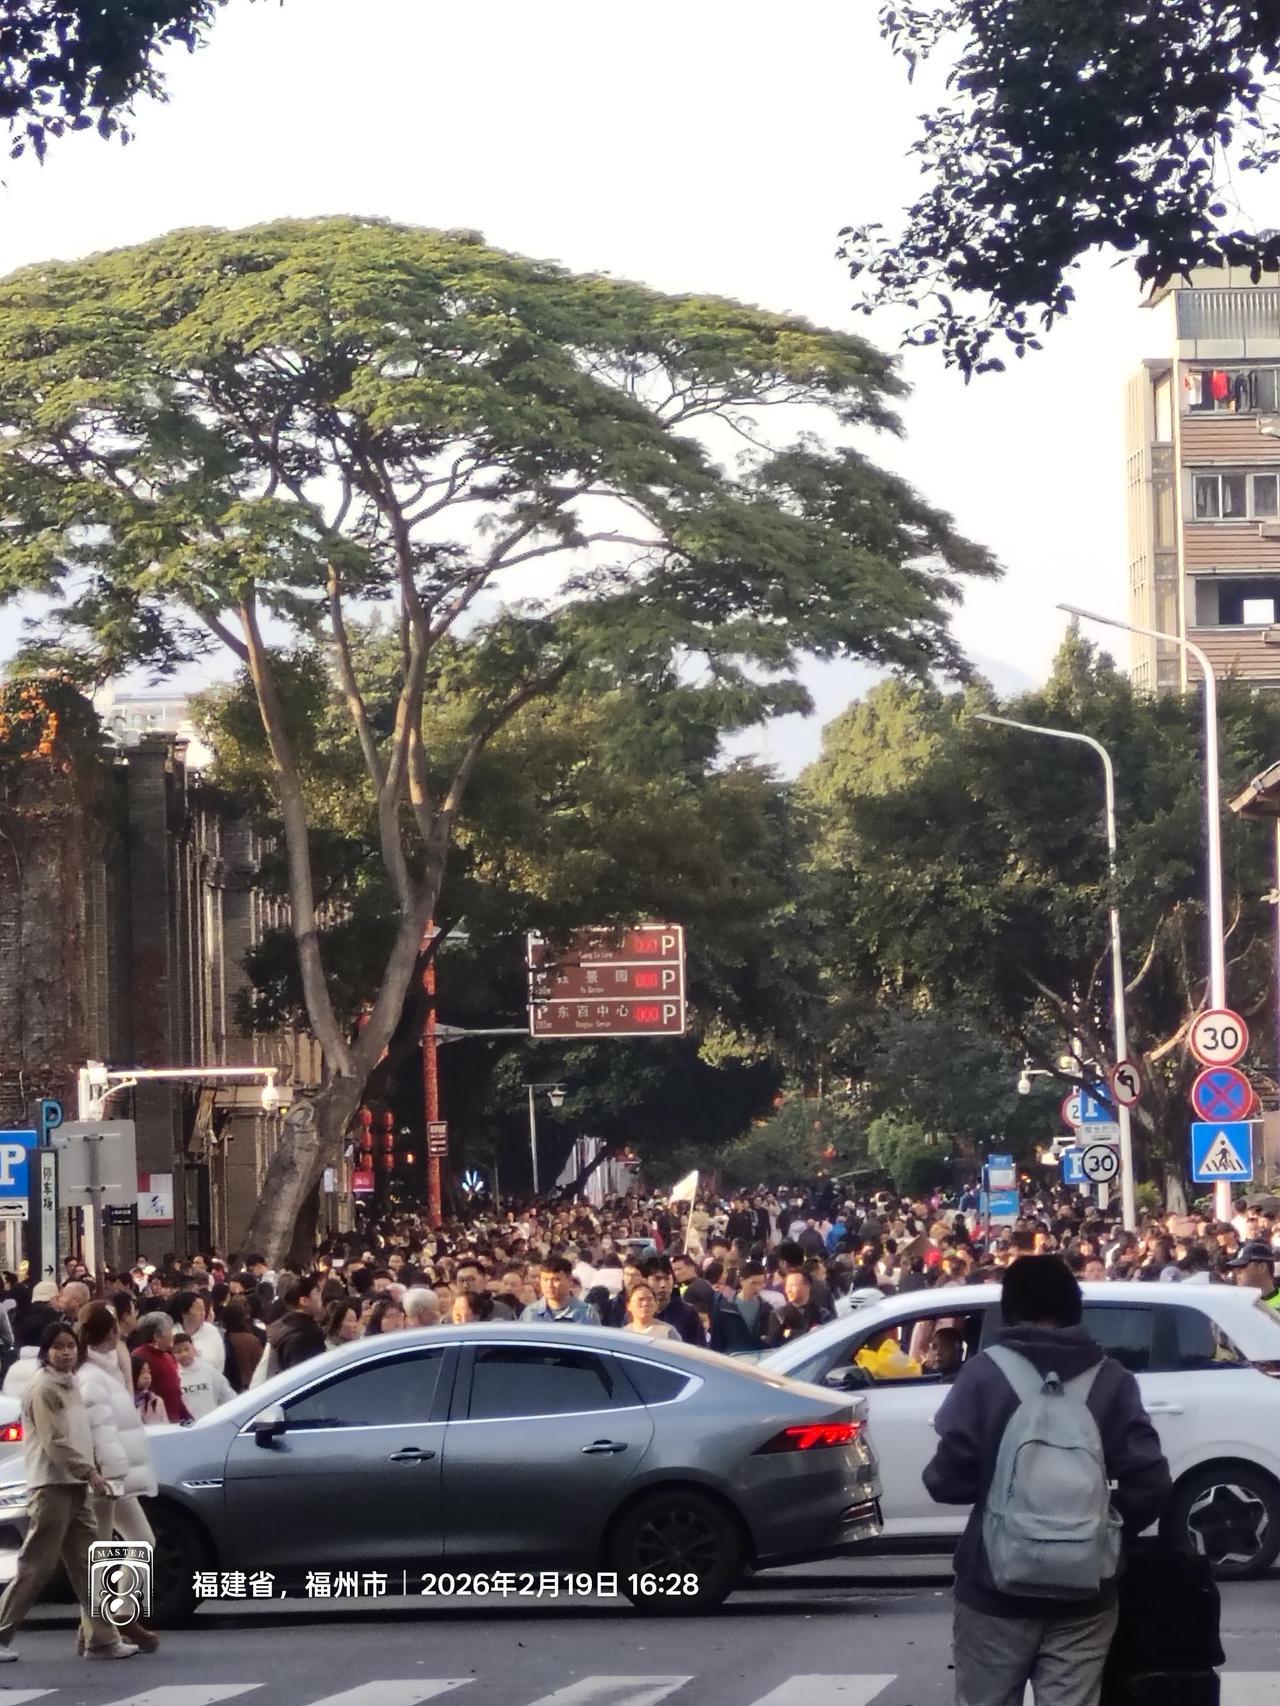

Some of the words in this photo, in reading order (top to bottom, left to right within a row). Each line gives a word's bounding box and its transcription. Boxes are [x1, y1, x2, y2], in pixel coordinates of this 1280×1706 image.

[661, 935, 675, 955] P
[662, 969, 676, 990] P
[557, 1004, 629, 1018] 东百中心
[663, 1004, 677, 1024] P
[1203, 1027, 1239, 1050] 30
[41, 1099, 64, 1148] P
[0, 1144, 26, 1185] P
[1088, 1155, 1114, 1172] 30
